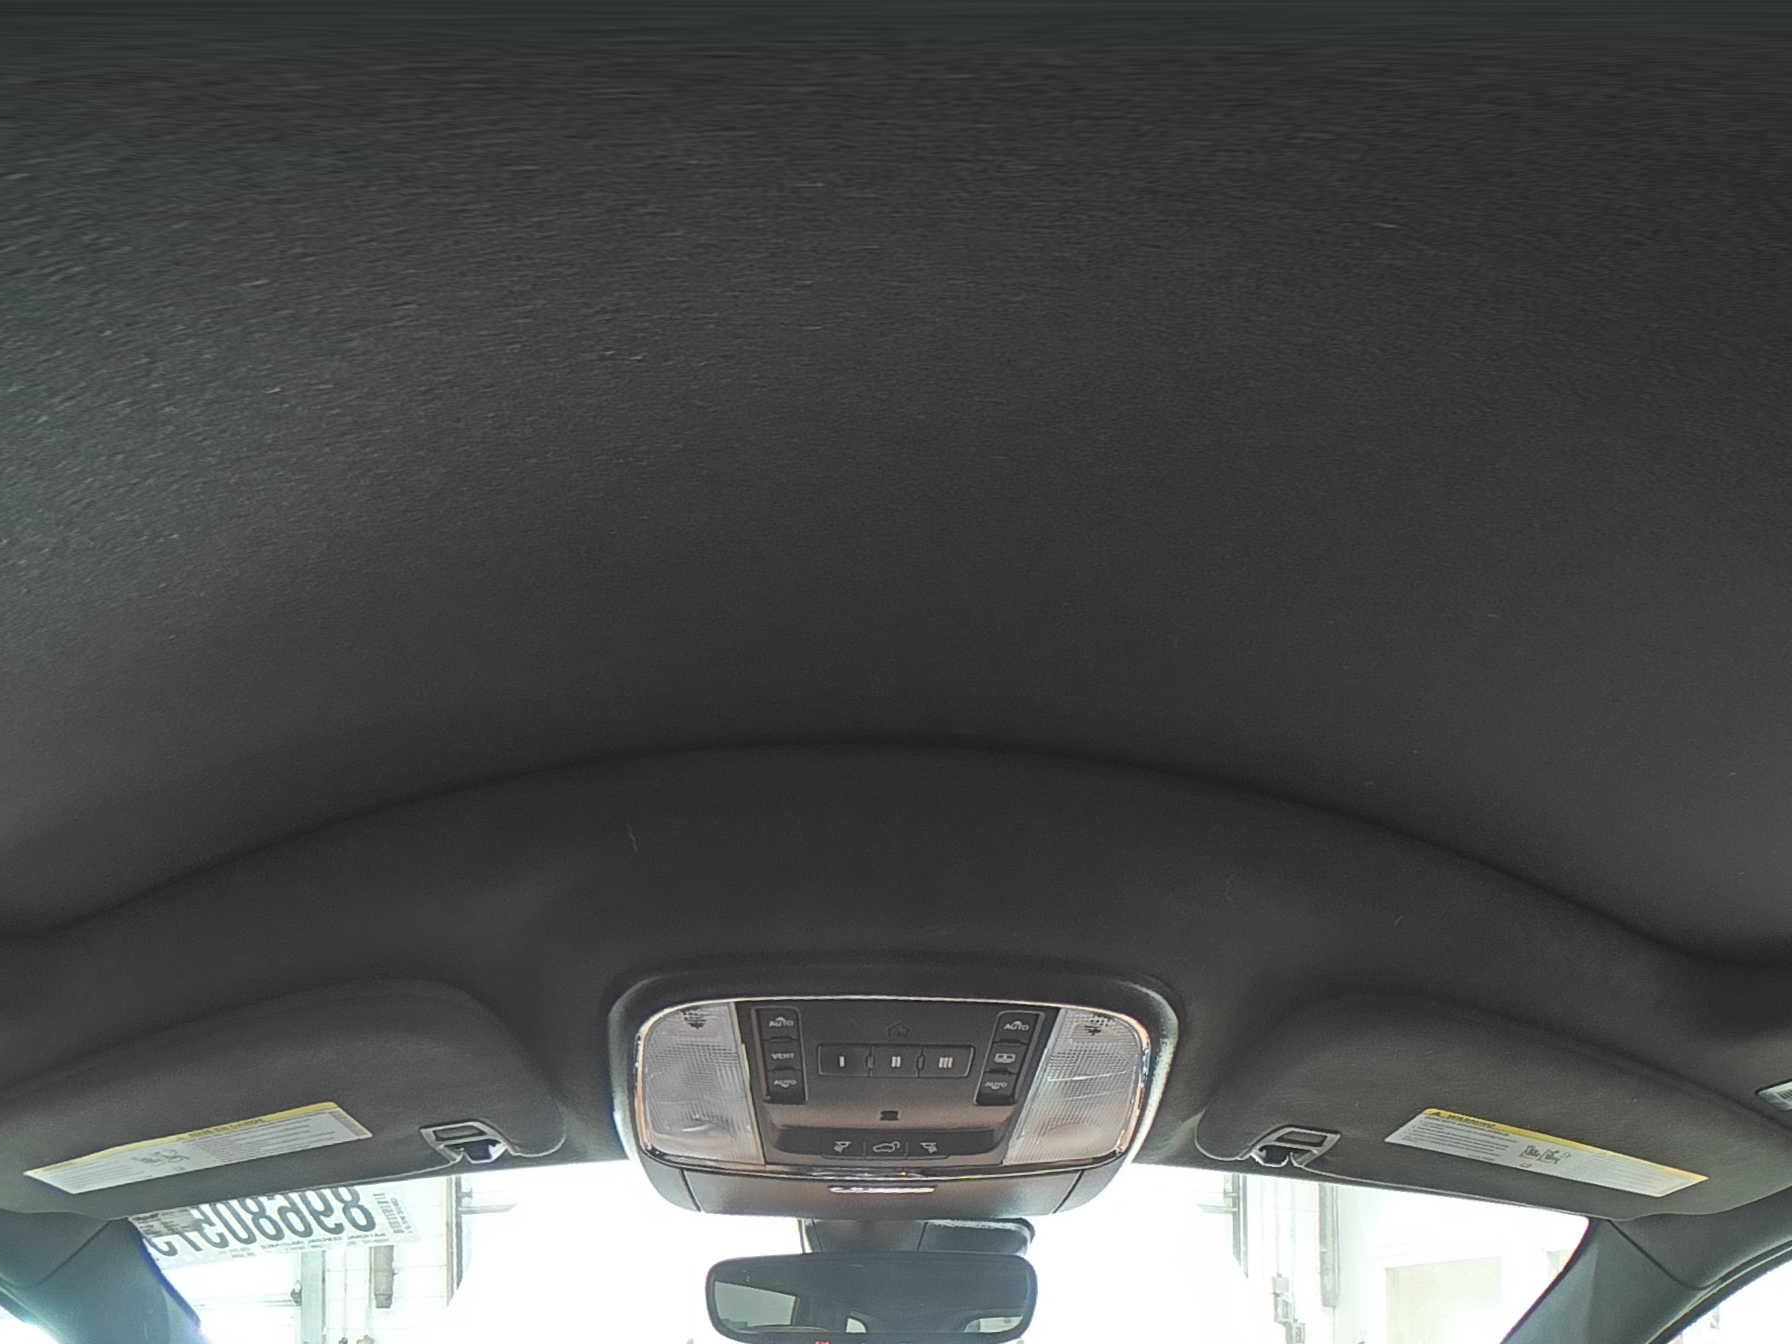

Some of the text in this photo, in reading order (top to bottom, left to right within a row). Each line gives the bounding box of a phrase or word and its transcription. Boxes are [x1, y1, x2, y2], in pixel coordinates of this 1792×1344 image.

[768, 1019, 794, 1028] AUTO
[1004, 1022, 1030, 1031] AUTO
[771, 1052, 795, 1060] VENT
[773, 1078, 798, 1087] AUTO
[984, 1080, 1009, 1089] AUTO
